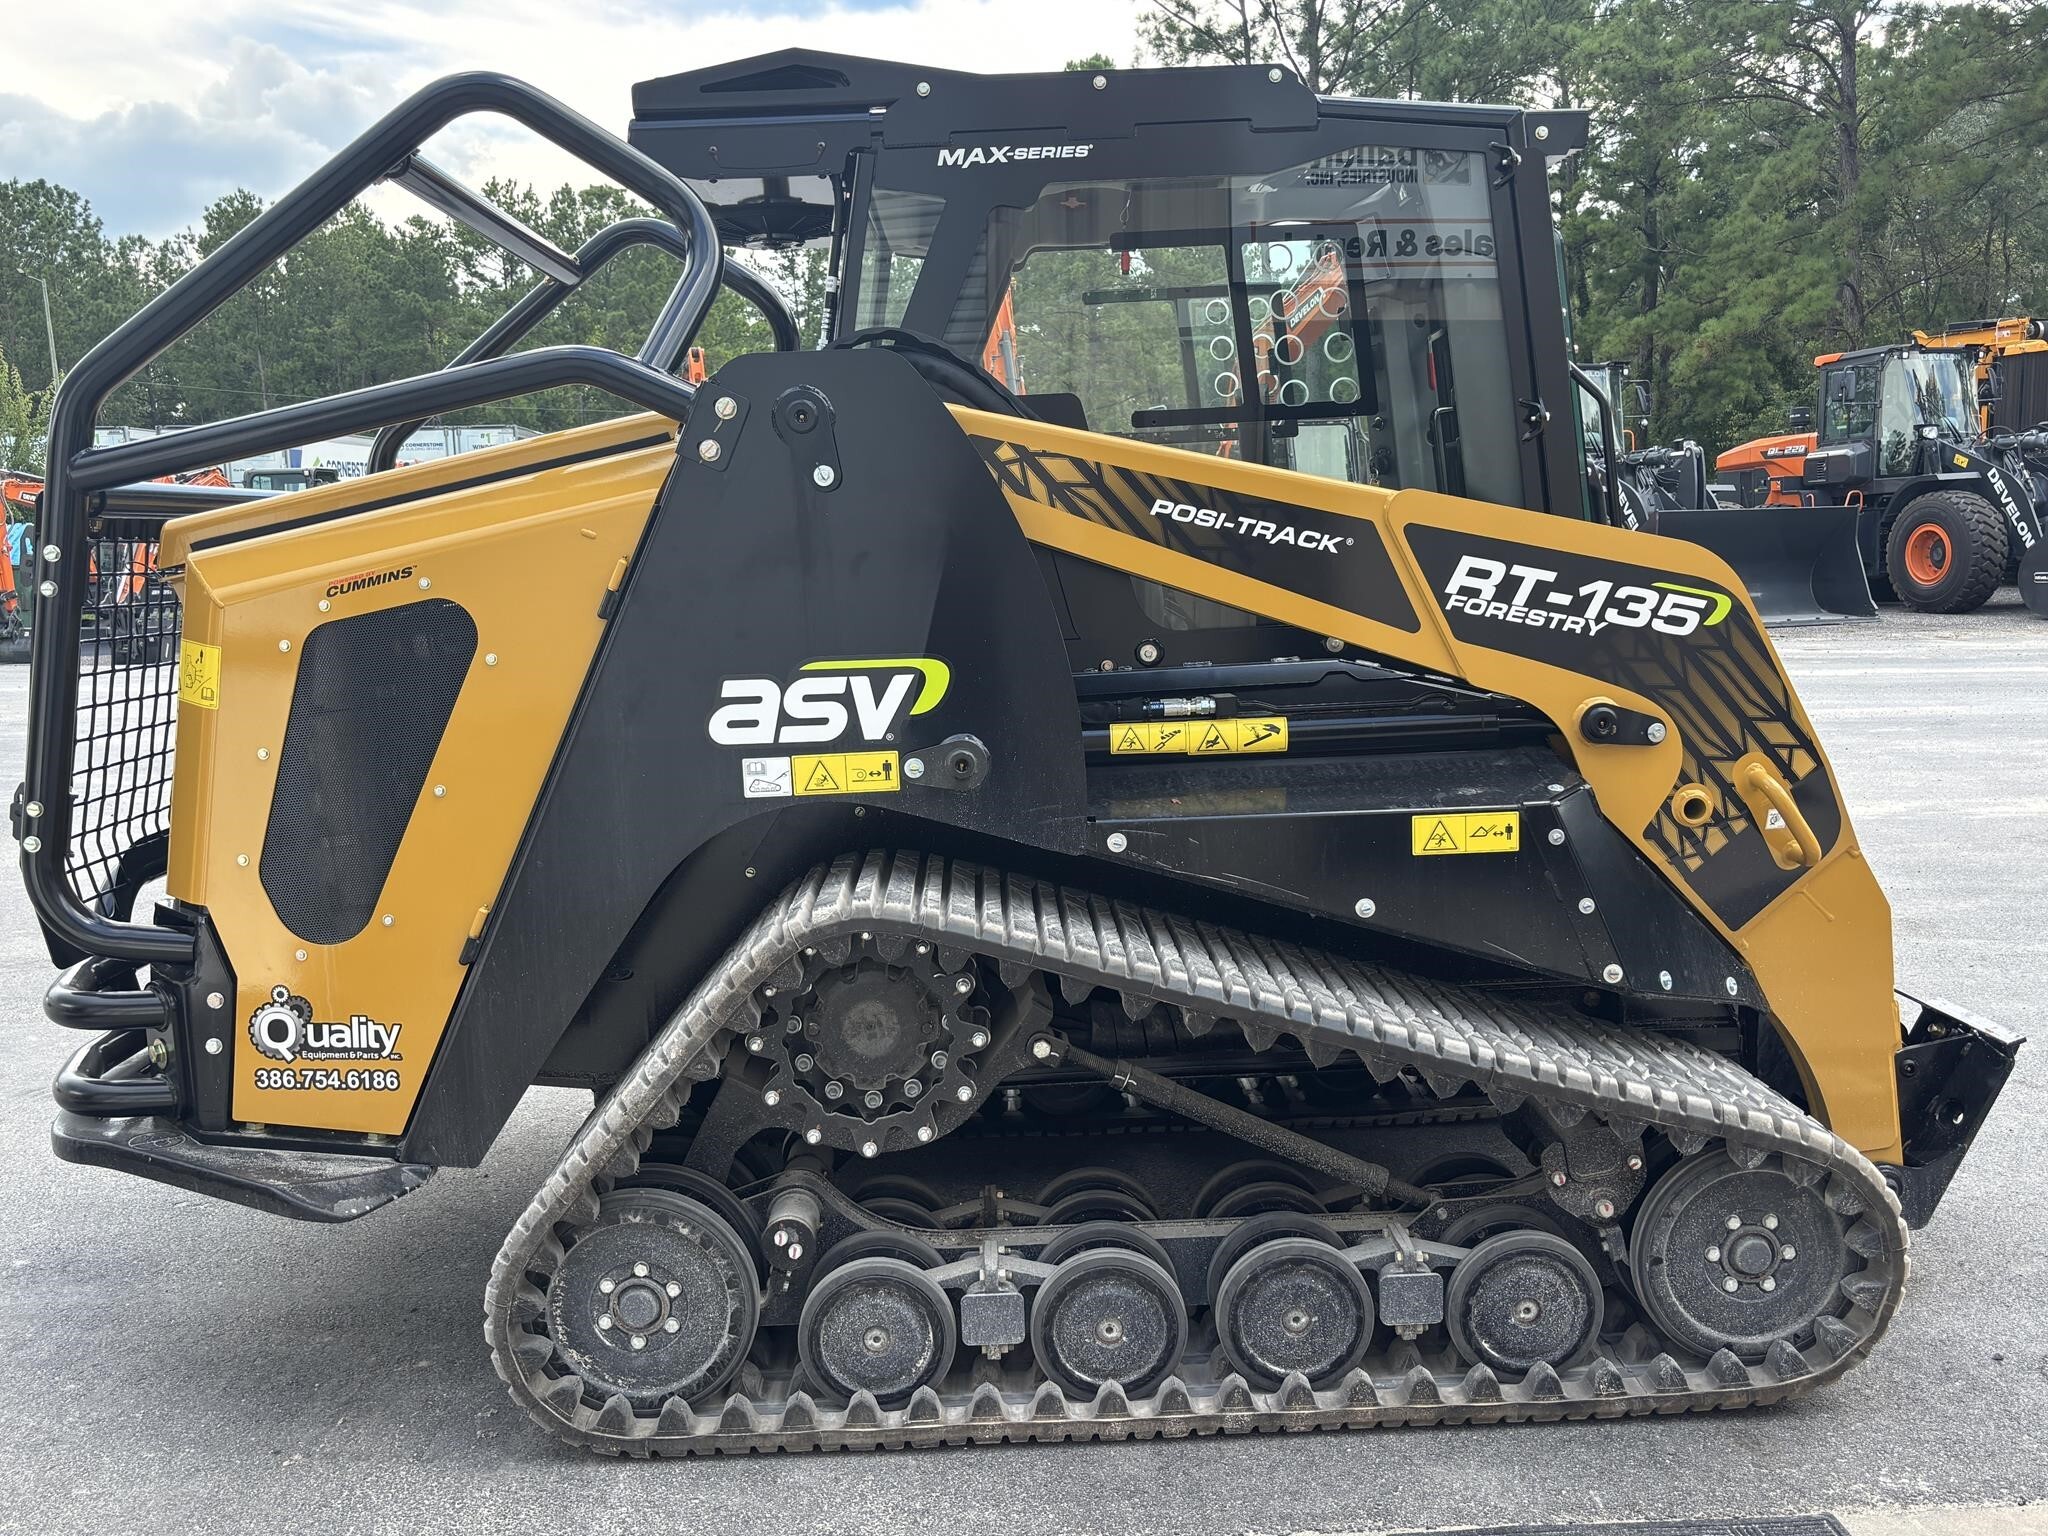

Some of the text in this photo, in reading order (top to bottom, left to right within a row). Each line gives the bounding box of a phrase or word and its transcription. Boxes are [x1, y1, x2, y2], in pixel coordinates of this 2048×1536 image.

[1289, 292, 1321, 328] DEVELON
[1986, 467, 2036, 549] DEVELON
[328, 570, 376, 586] POWERED BY
[1444, 554, 1708, 636] RT-135
[1444, 594, 1608, 637] FORESTRY
[259, 1012, 401, 1063] Quality
[301, 1050, 349, 1061] Equipment
[350, 1050, 356, 1060] &
[357, 1050, 379, 1060] Parts
[257, 1069, 399, 1090] 386.754.6186
